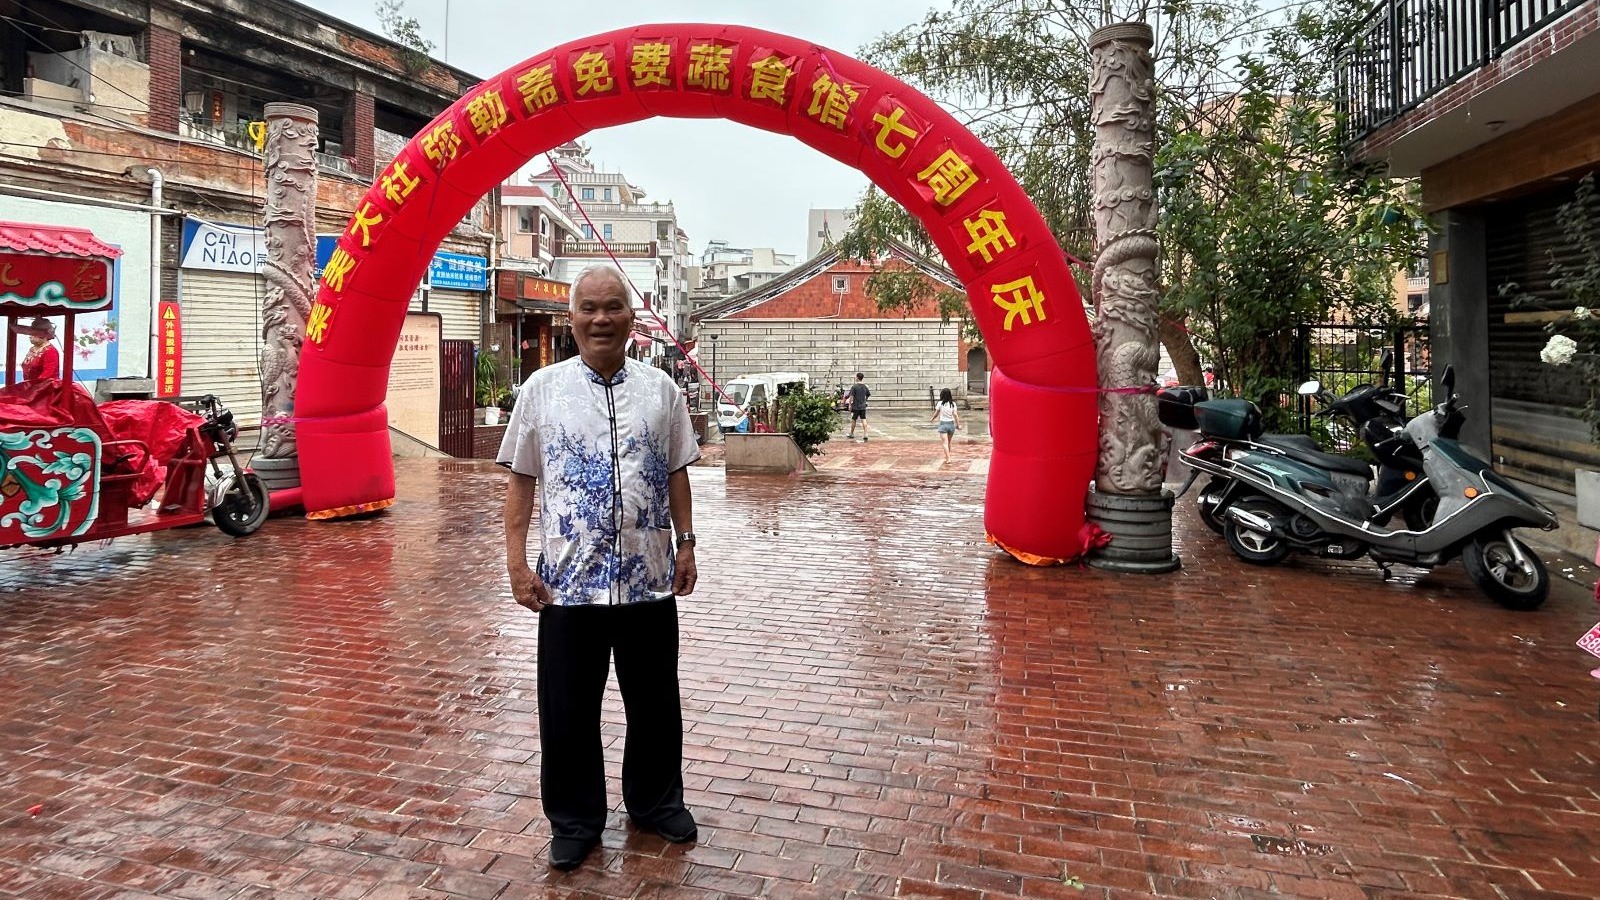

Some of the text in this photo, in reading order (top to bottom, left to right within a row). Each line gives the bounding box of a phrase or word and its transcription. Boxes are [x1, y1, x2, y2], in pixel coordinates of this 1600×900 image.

[204, 231, 237, 249] CAI
[164, 320, 175, 394] 外墙脱落 请勿靠近
